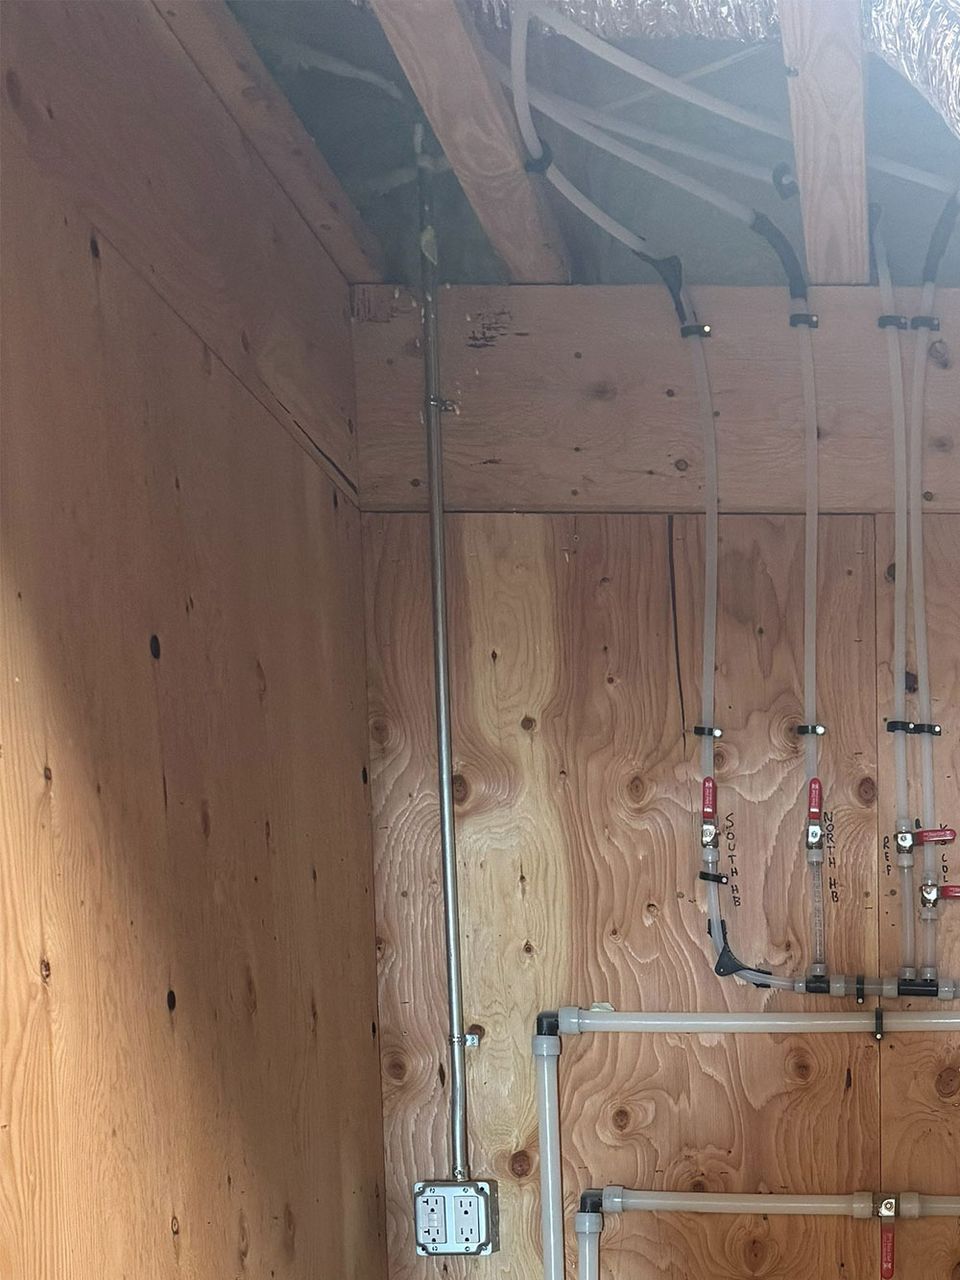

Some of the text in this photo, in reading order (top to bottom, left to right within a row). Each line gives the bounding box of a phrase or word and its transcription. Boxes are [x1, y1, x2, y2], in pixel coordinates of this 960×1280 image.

[725, 812, 741, 907] SOUTH HB
[823, 811, 839, 903] NORTH HB
[883, 835, 892, 876] REF
